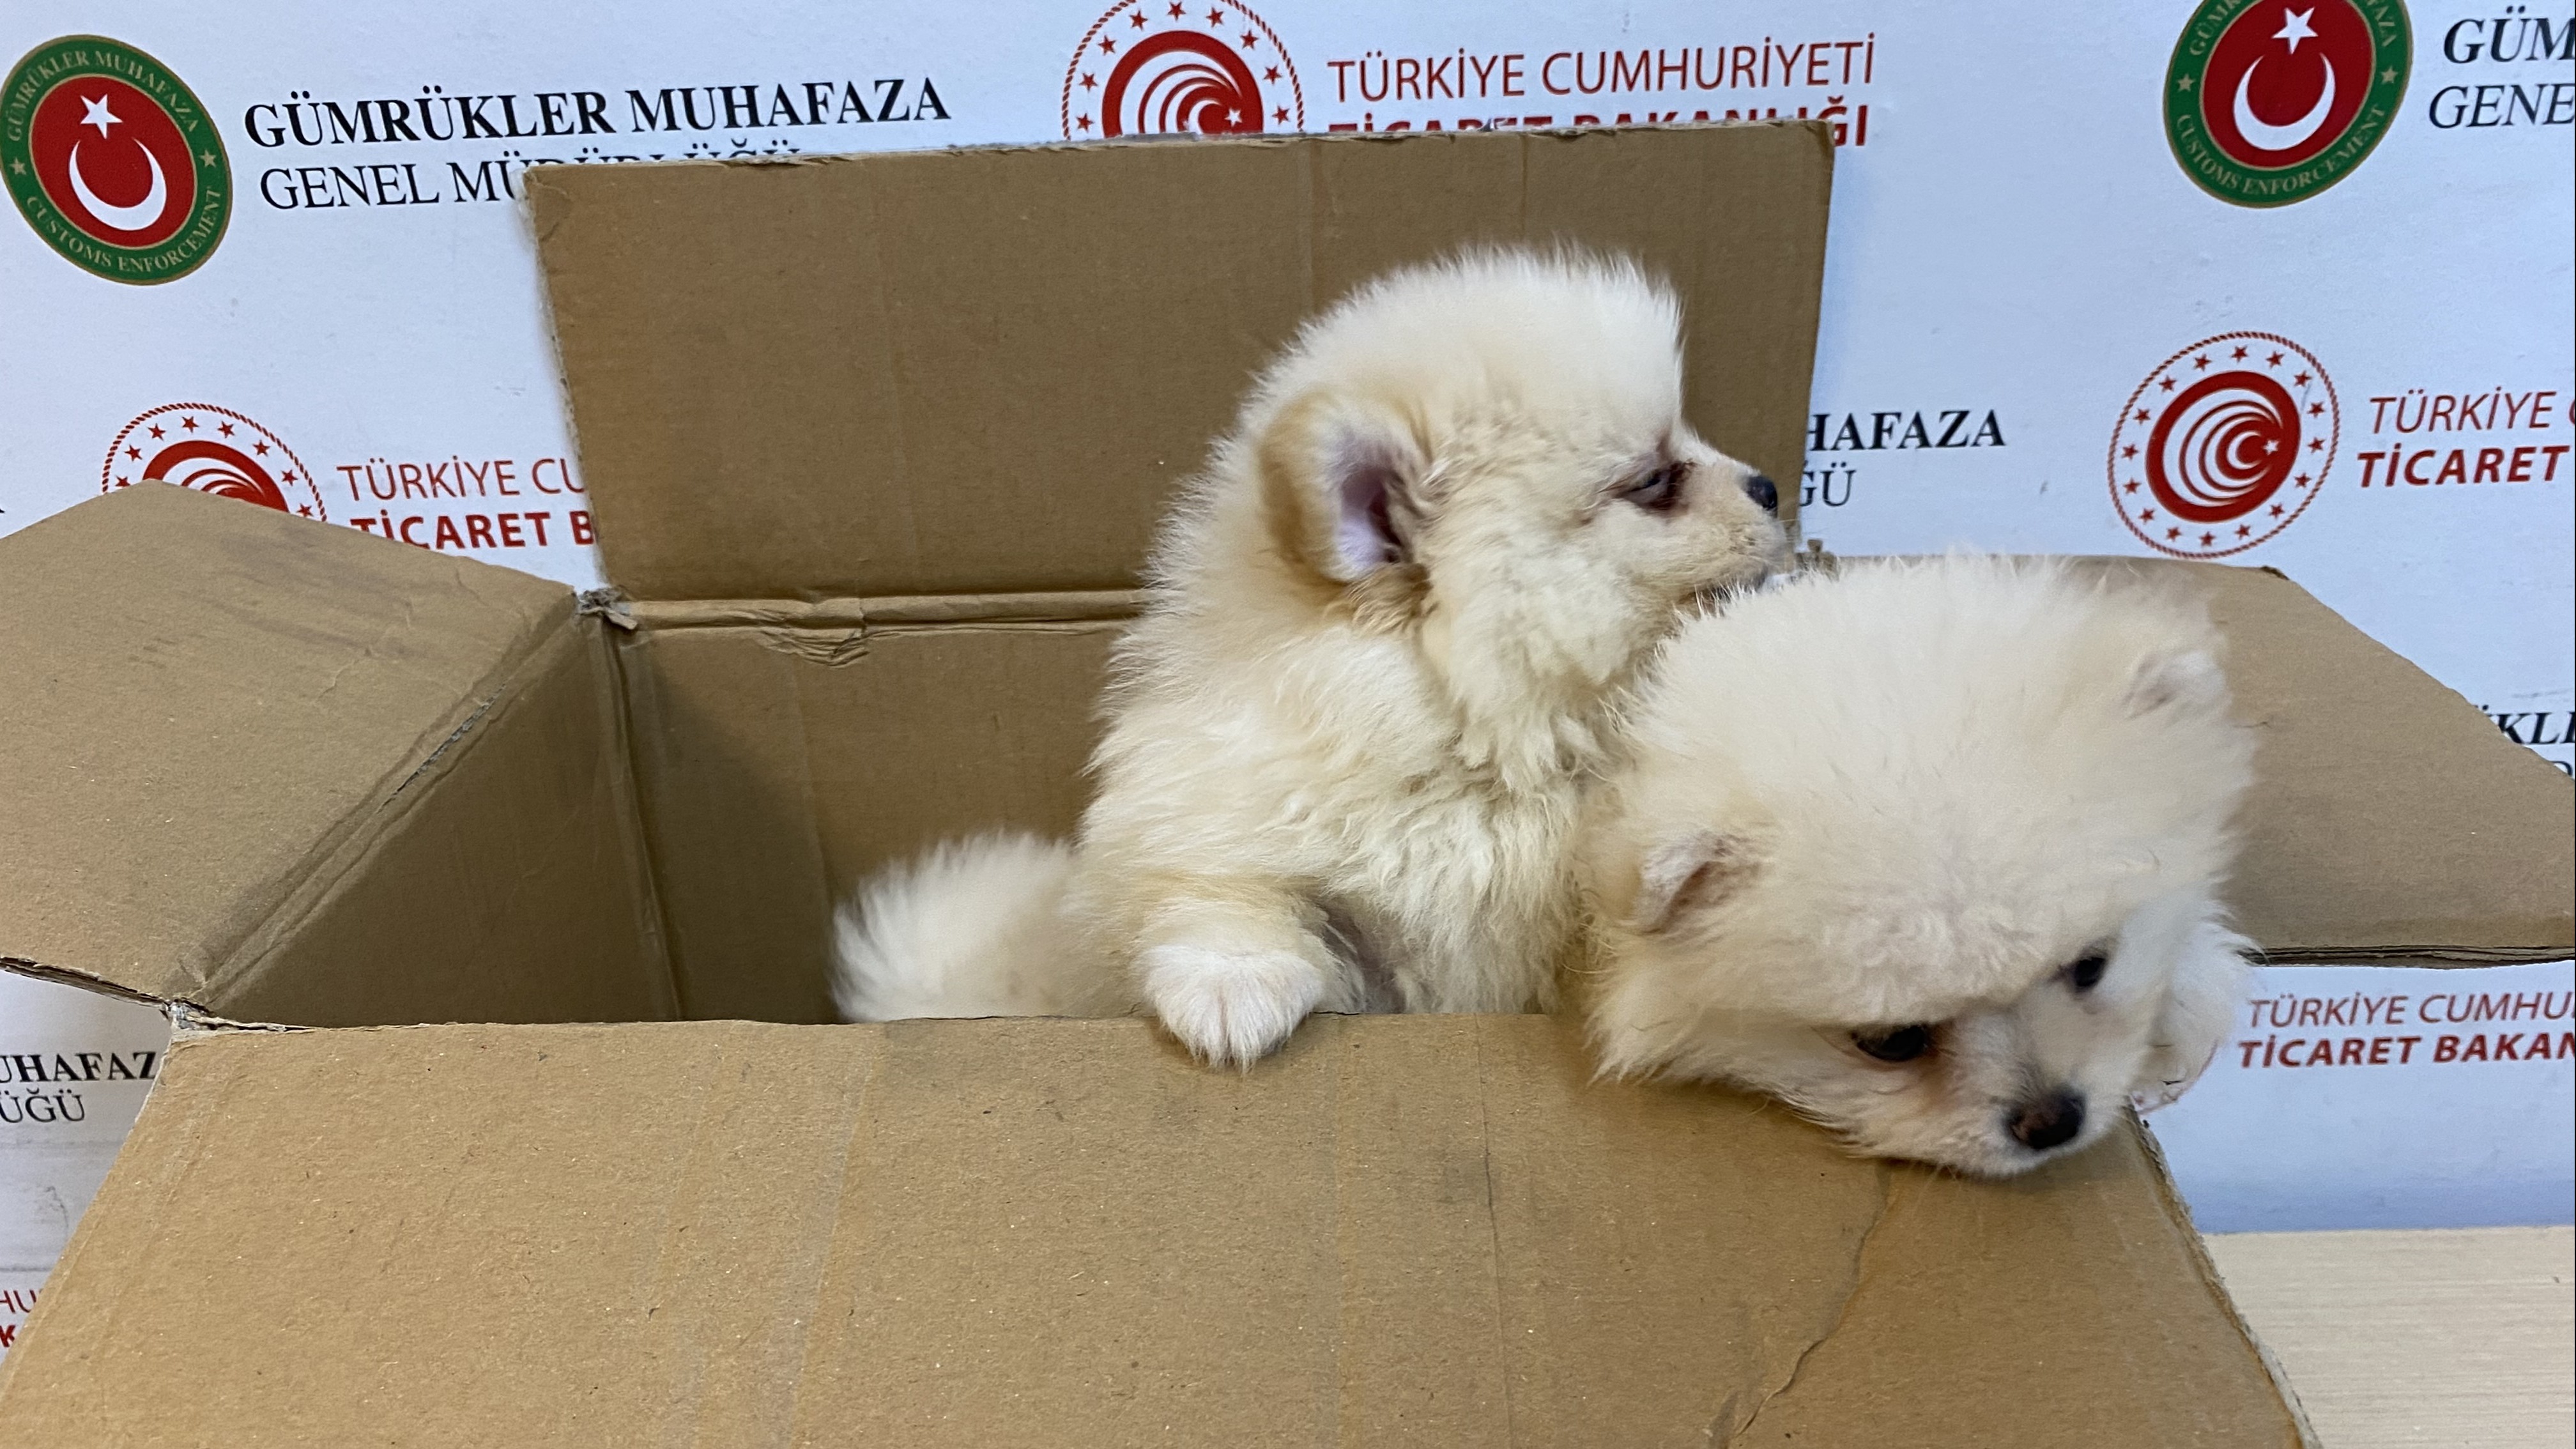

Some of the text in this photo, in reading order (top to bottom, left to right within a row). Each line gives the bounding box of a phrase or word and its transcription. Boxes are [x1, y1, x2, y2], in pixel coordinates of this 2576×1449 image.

[2444, 5, 2575, 64] GÜM
[1327, 33, 1875, 103] TÜRKİYE CUMHURİYETİ
[7, 50, 198, 142] GÜMRÜKLER MUHAFAZA
[244, 77, 951, 148] GÜMRÜKLER MUHAFAZA
[2177, 103, 2385, 194] CUSTOMS ENFORCEMENT
[261, 164, 440, 210] GENEL
[26, 186, 222, 273] CUSTOMS ENFORCEMENT
[2370, 387, 2557, 433] TÜRKİYE
[337, 455, 520, 501] TÜRKİYE
[2358, 442, 2570, 487] TİCARET
[2248, 991, 2575, 1028] TÜRKİYE CUMHU
[2238, 1034, 2422, 1068] TİCARET
